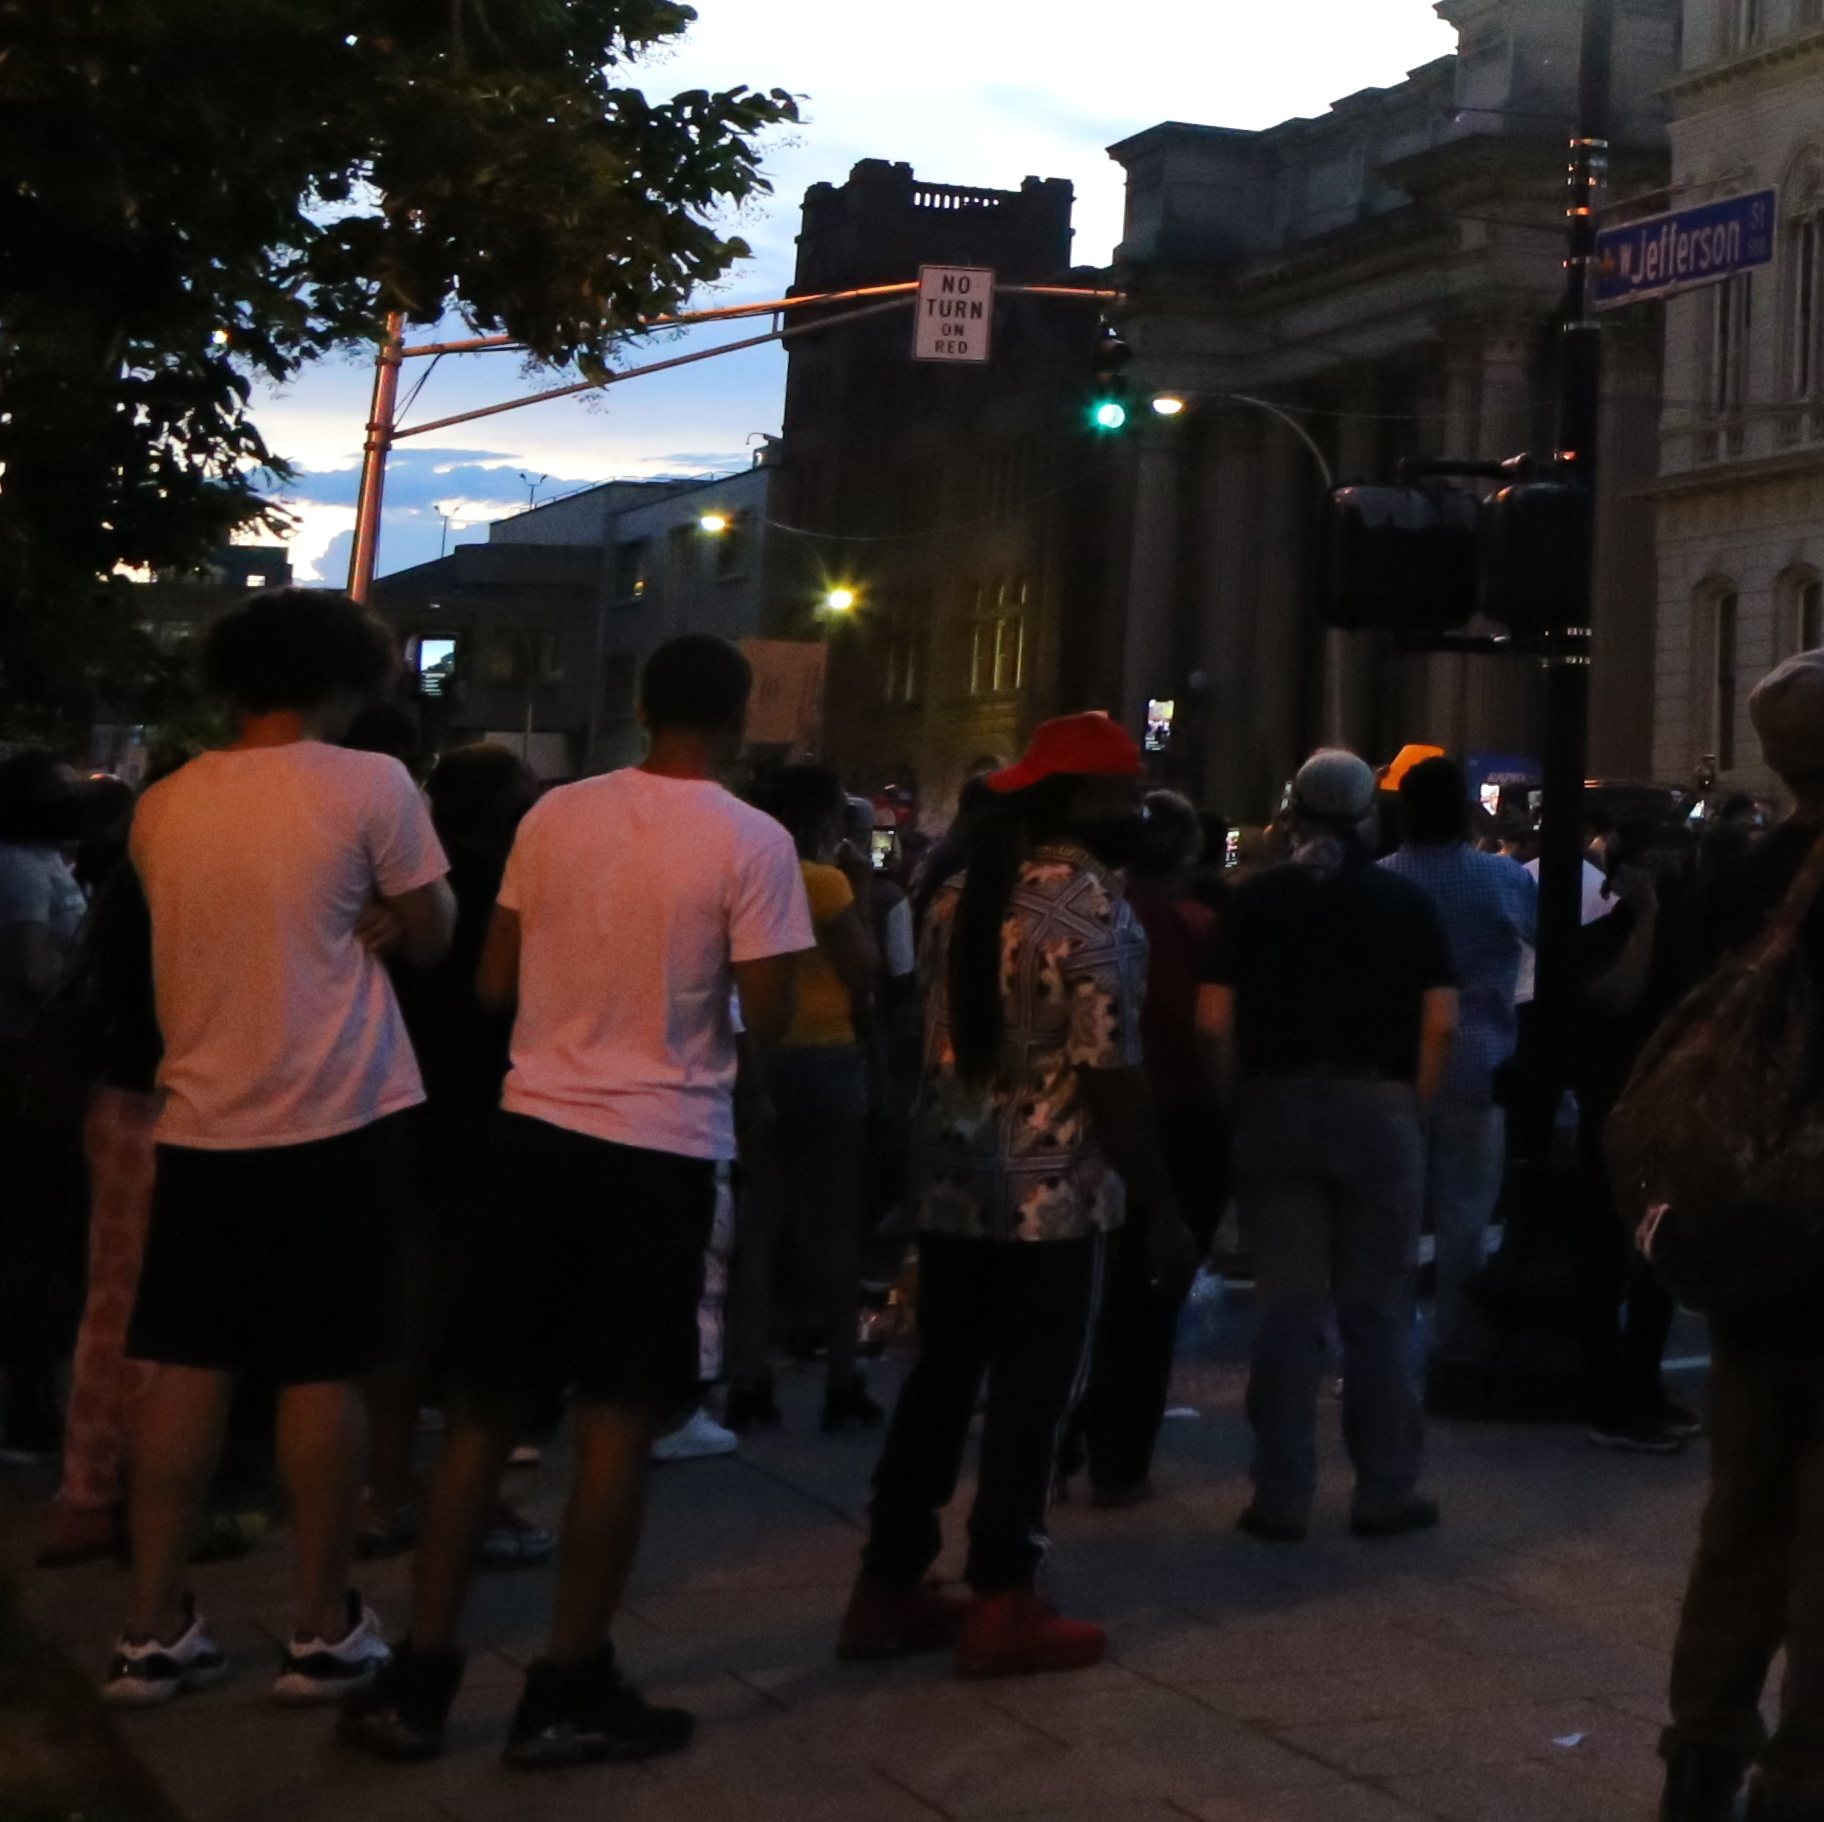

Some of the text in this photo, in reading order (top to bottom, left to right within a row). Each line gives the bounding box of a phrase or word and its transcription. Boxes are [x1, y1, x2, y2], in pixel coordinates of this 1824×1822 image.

[1630, 220, 1740, 284] Jefferson
[942, 275, 970, 294] NO
[927, 299, 982, 319] TURN
[941, 324, 964, 336] ON
[935, 341, 968, 354] RED
